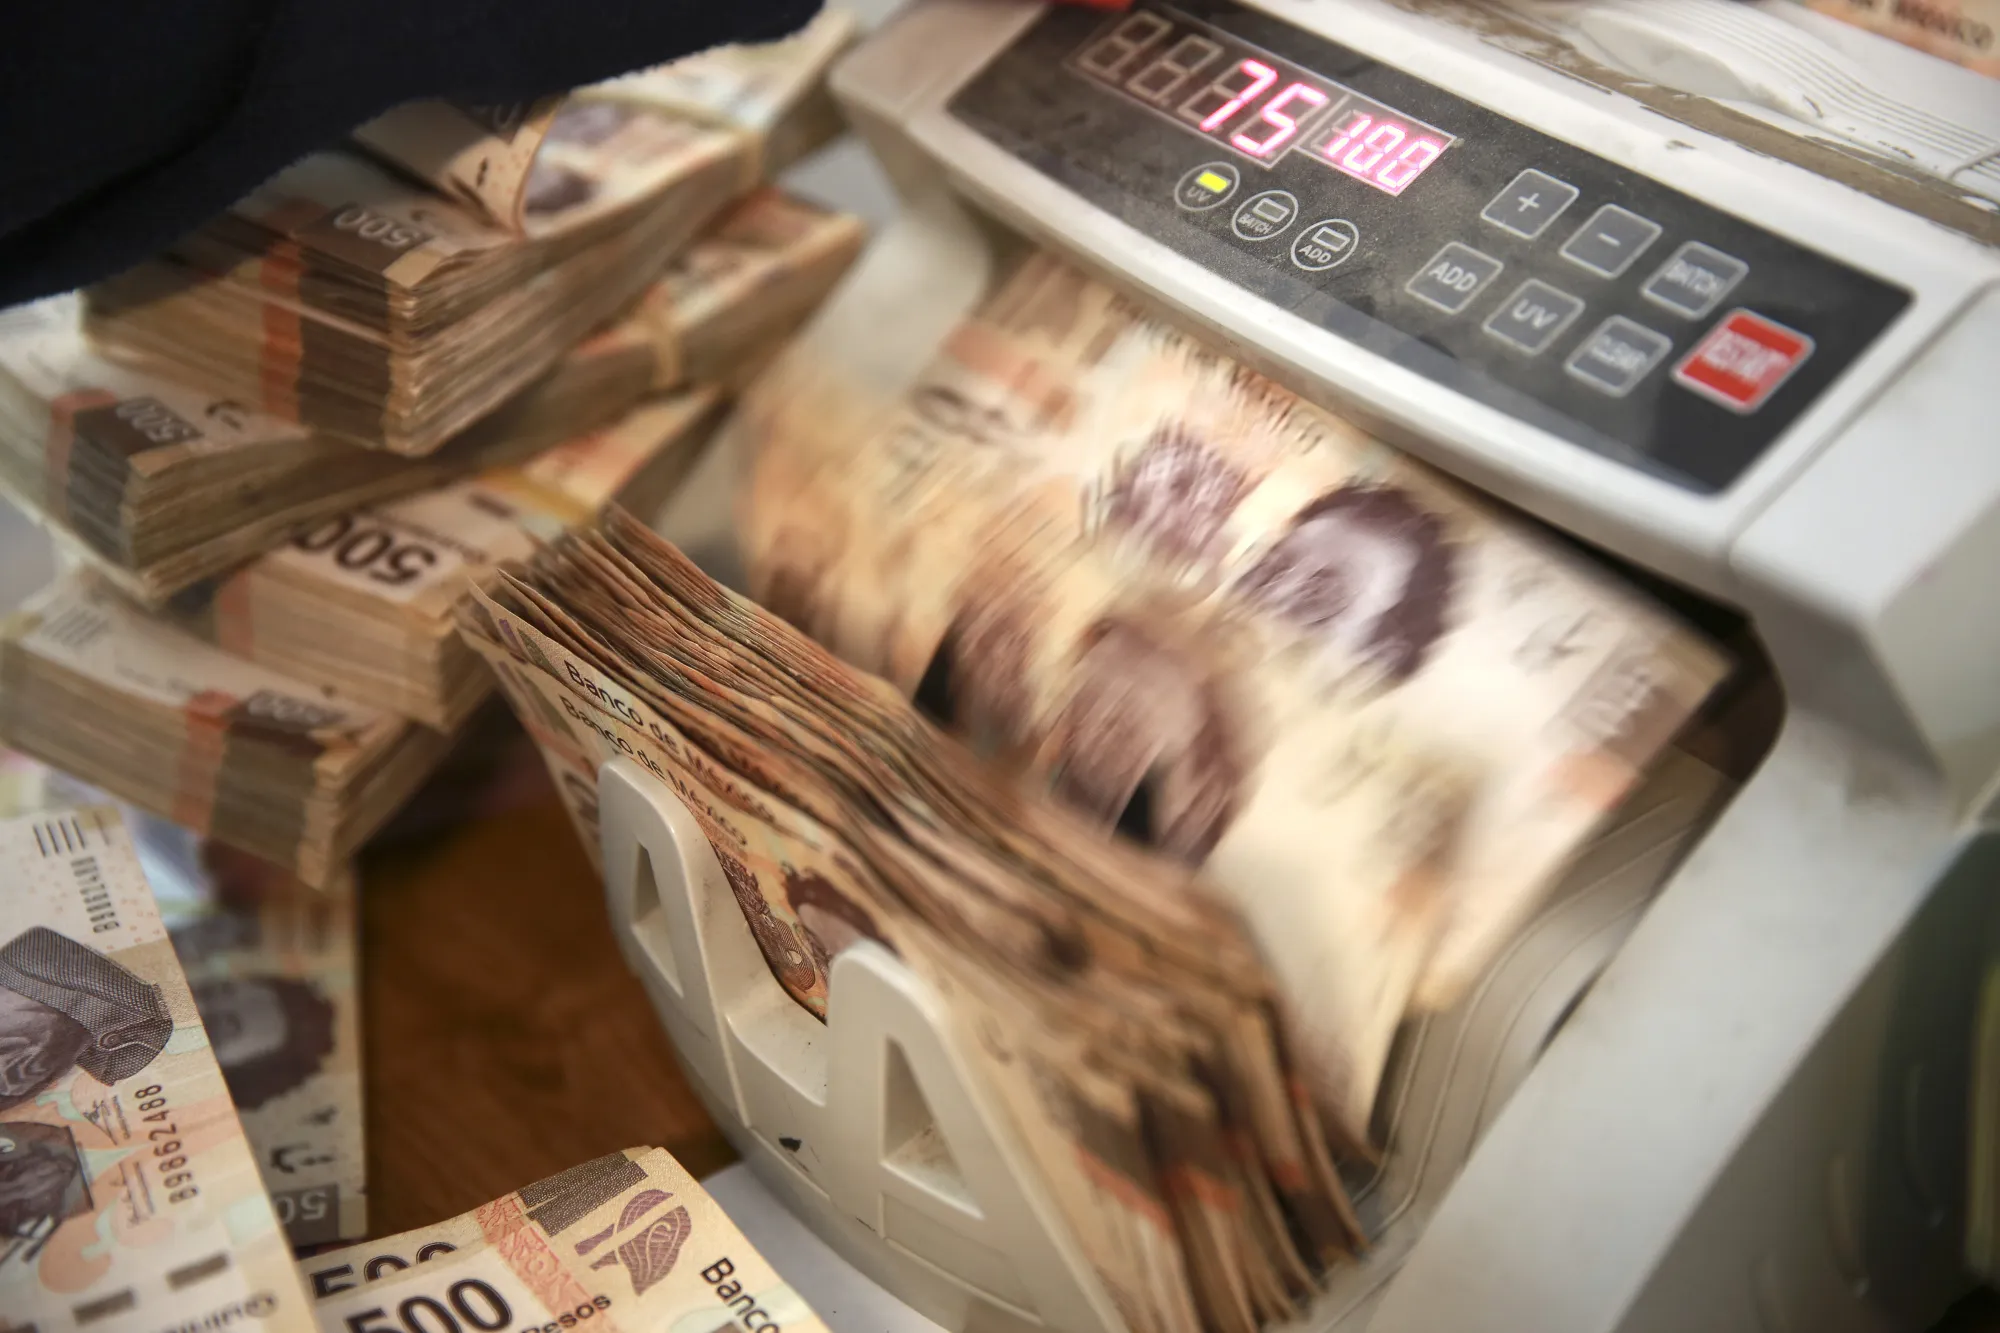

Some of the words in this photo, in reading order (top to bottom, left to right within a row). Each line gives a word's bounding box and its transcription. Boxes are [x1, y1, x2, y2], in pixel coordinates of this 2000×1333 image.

[1200, 58, 1327, 156] 75
[1327, 116, 1442, 189] 100
[1186, 186, 1212, 202] UV
[333, 209, 421, 247] 500
[1237, 212, 1274, 235] BATCH
[1298, 244, 1332, 264] ADD
[1428, 261, 1478, 293] ADD
[1511, 298, 1559, 330] UV
[291, 512, 437, 586] 500
[563, 659, 644, 726] Banco
[649, 722, 680, 754] de
[559, 694, 634, 755] Banco
[636, 749, 666, 780] de
[521, 1295, 611, 1333] esos
